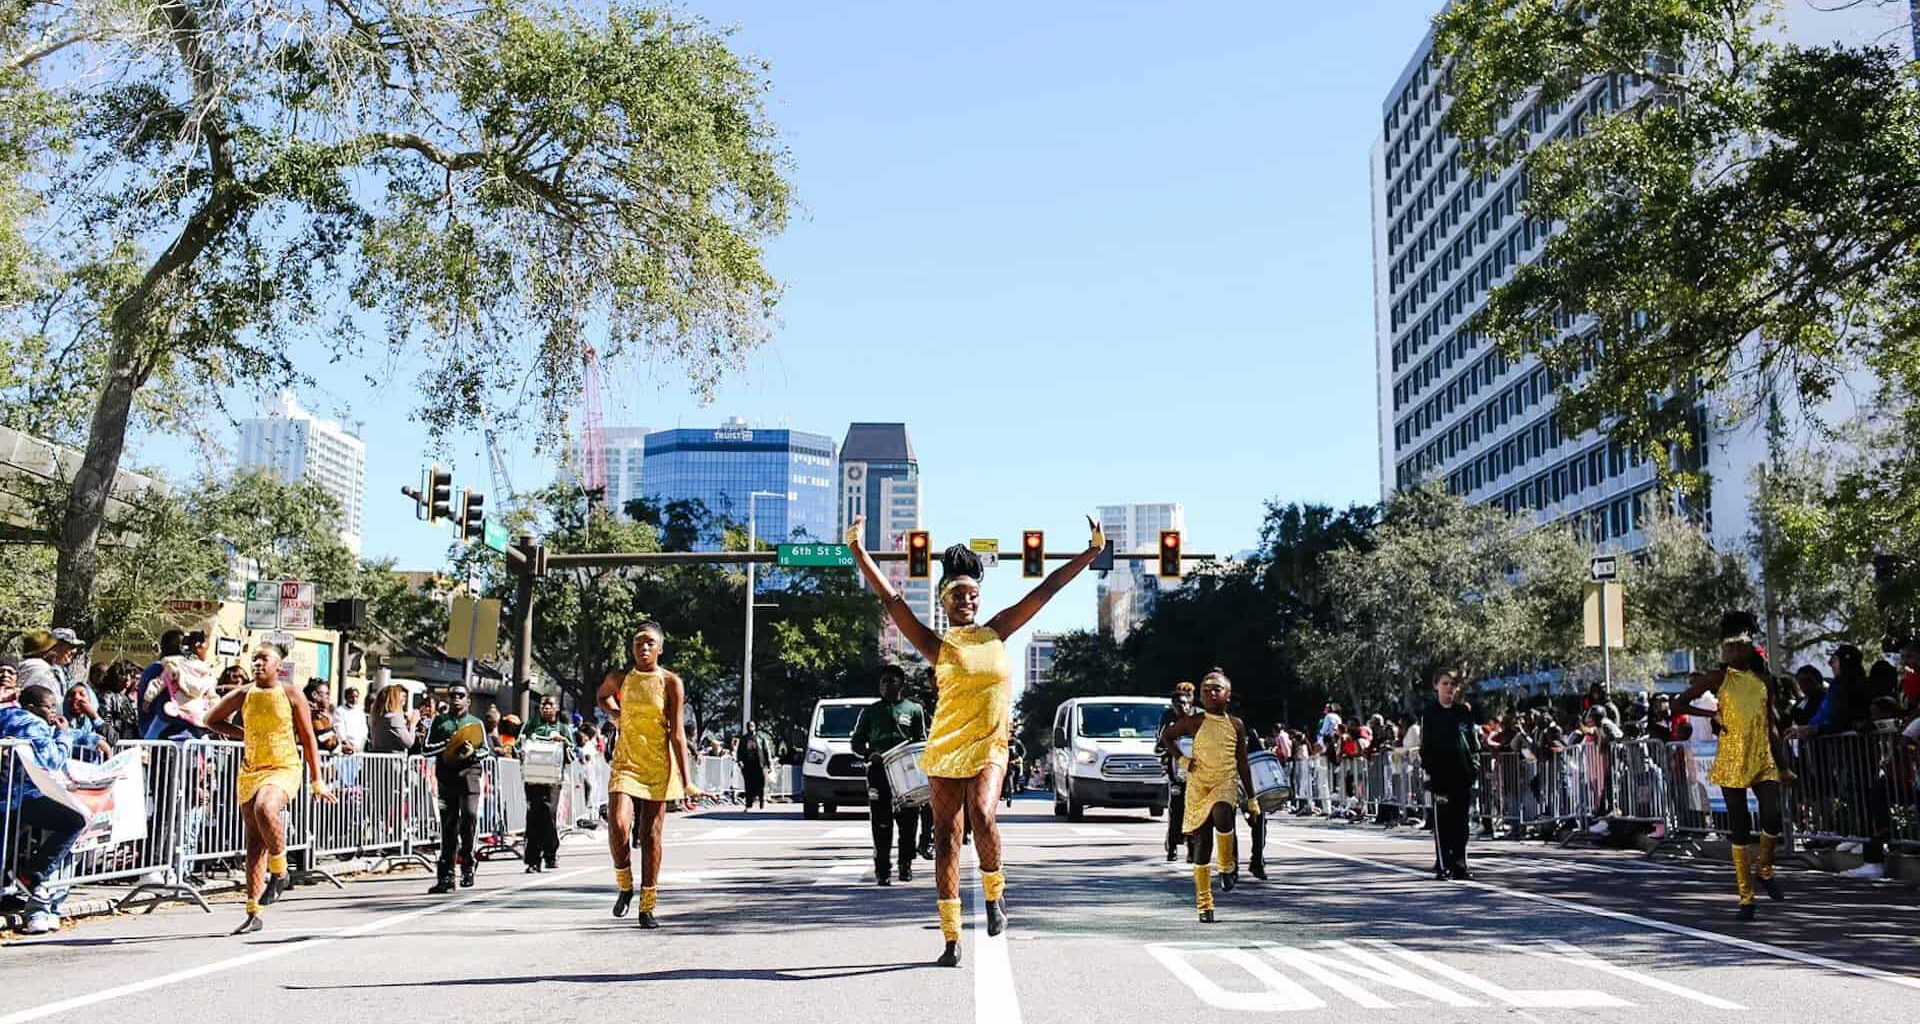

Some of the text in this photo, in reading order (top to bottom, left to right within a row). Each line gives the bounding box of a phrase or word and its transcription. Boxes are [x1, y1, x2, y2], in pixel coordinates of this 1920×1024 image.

[791, 546, 842, 556] 6th St S
[839, 557, 854, 565] 100
[247, 585, 257, 599] 2
[282, 585, 298, 599] NO
